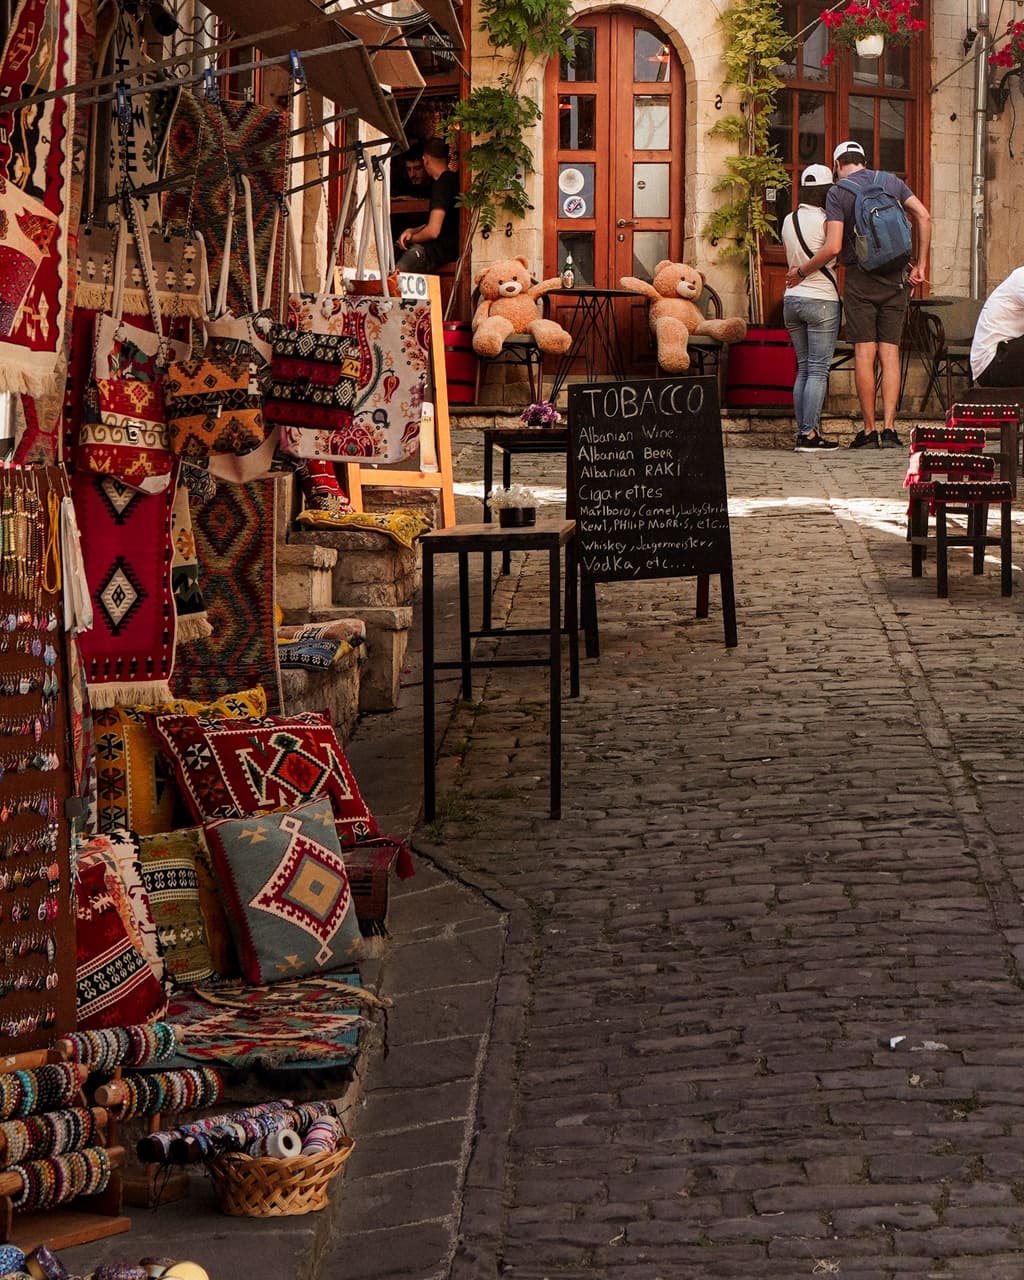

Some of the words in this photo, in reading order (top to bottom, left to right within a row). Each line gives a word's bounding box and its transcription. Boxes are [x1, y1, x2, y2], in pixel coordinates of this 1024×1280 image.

[582, 384, 704, 419] TOBACCO
[579, 426, 633, 444] Albanian
[578, 446, 635, 463] Albanian
[580, 466, 636, 480] Albanian
[578, 484, 664, 508] Cigarettes
